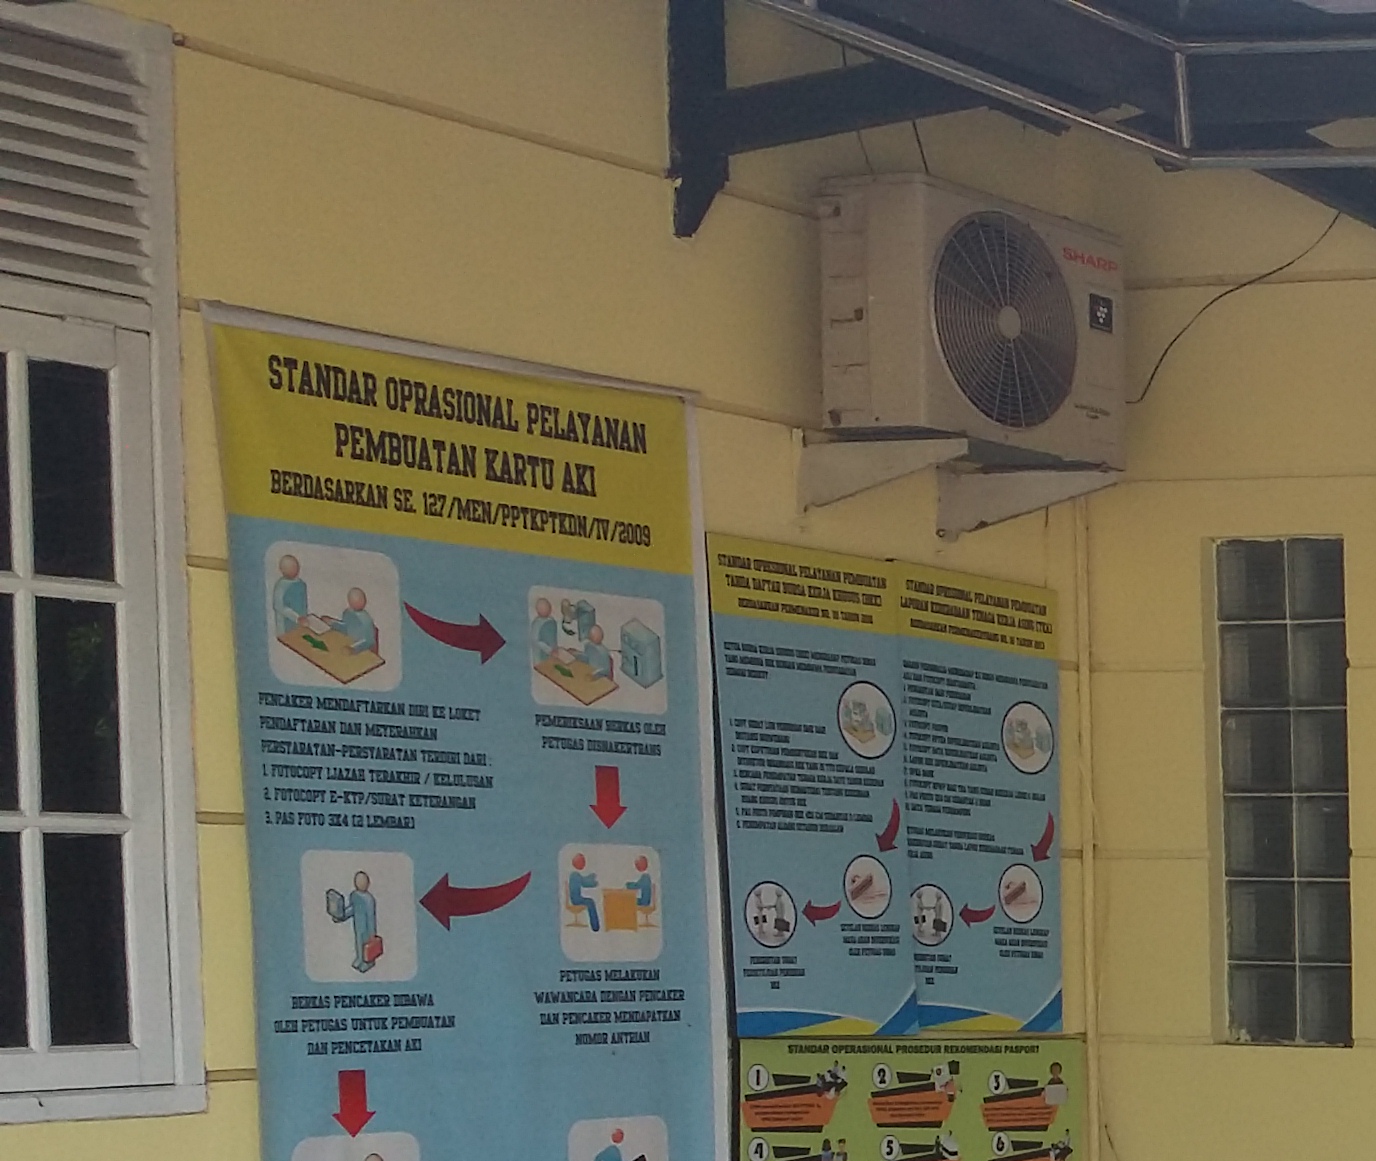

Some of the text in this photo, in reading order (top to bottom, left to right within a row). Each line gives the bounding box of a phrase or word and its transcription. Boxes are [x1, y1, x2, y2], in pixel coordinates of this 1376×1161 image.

[268, 354, 647, 454] STANDAR OPRASIONAL PELAYANAN
[334, 422, 477, 478] PEMBUATAN
[484, 448, 554, 490] KARTU
[270, 469, 388, 509] BERDASARKAN
[258, 692, 313, 708] PENCAKER
[316, 696, 405, 715] MENDAFTARKAN
[448, 707, 481, 721] LOKET
[259, 716, 336, 733] PENDAFTARAN
[339, 721, 362, 736] DAN
[271, 764, 323, 780] FOTOCOPY
[274, 787, 326, 803] FOTOCOPY
[275, 811, 295, 825] PAS
[298, 812, 325, 826] FOTO
[559, 970, 602, 982] PETUGAS
[301, 1018, 348, 1032] PETUGAS
[787, 1044, 830, 1054] STANDAR
[831, 1044, 893, 1054] OPERASIONAL
[877, 1068, 887, 1084] 2
[886, 1140, 893, 1155] 5
